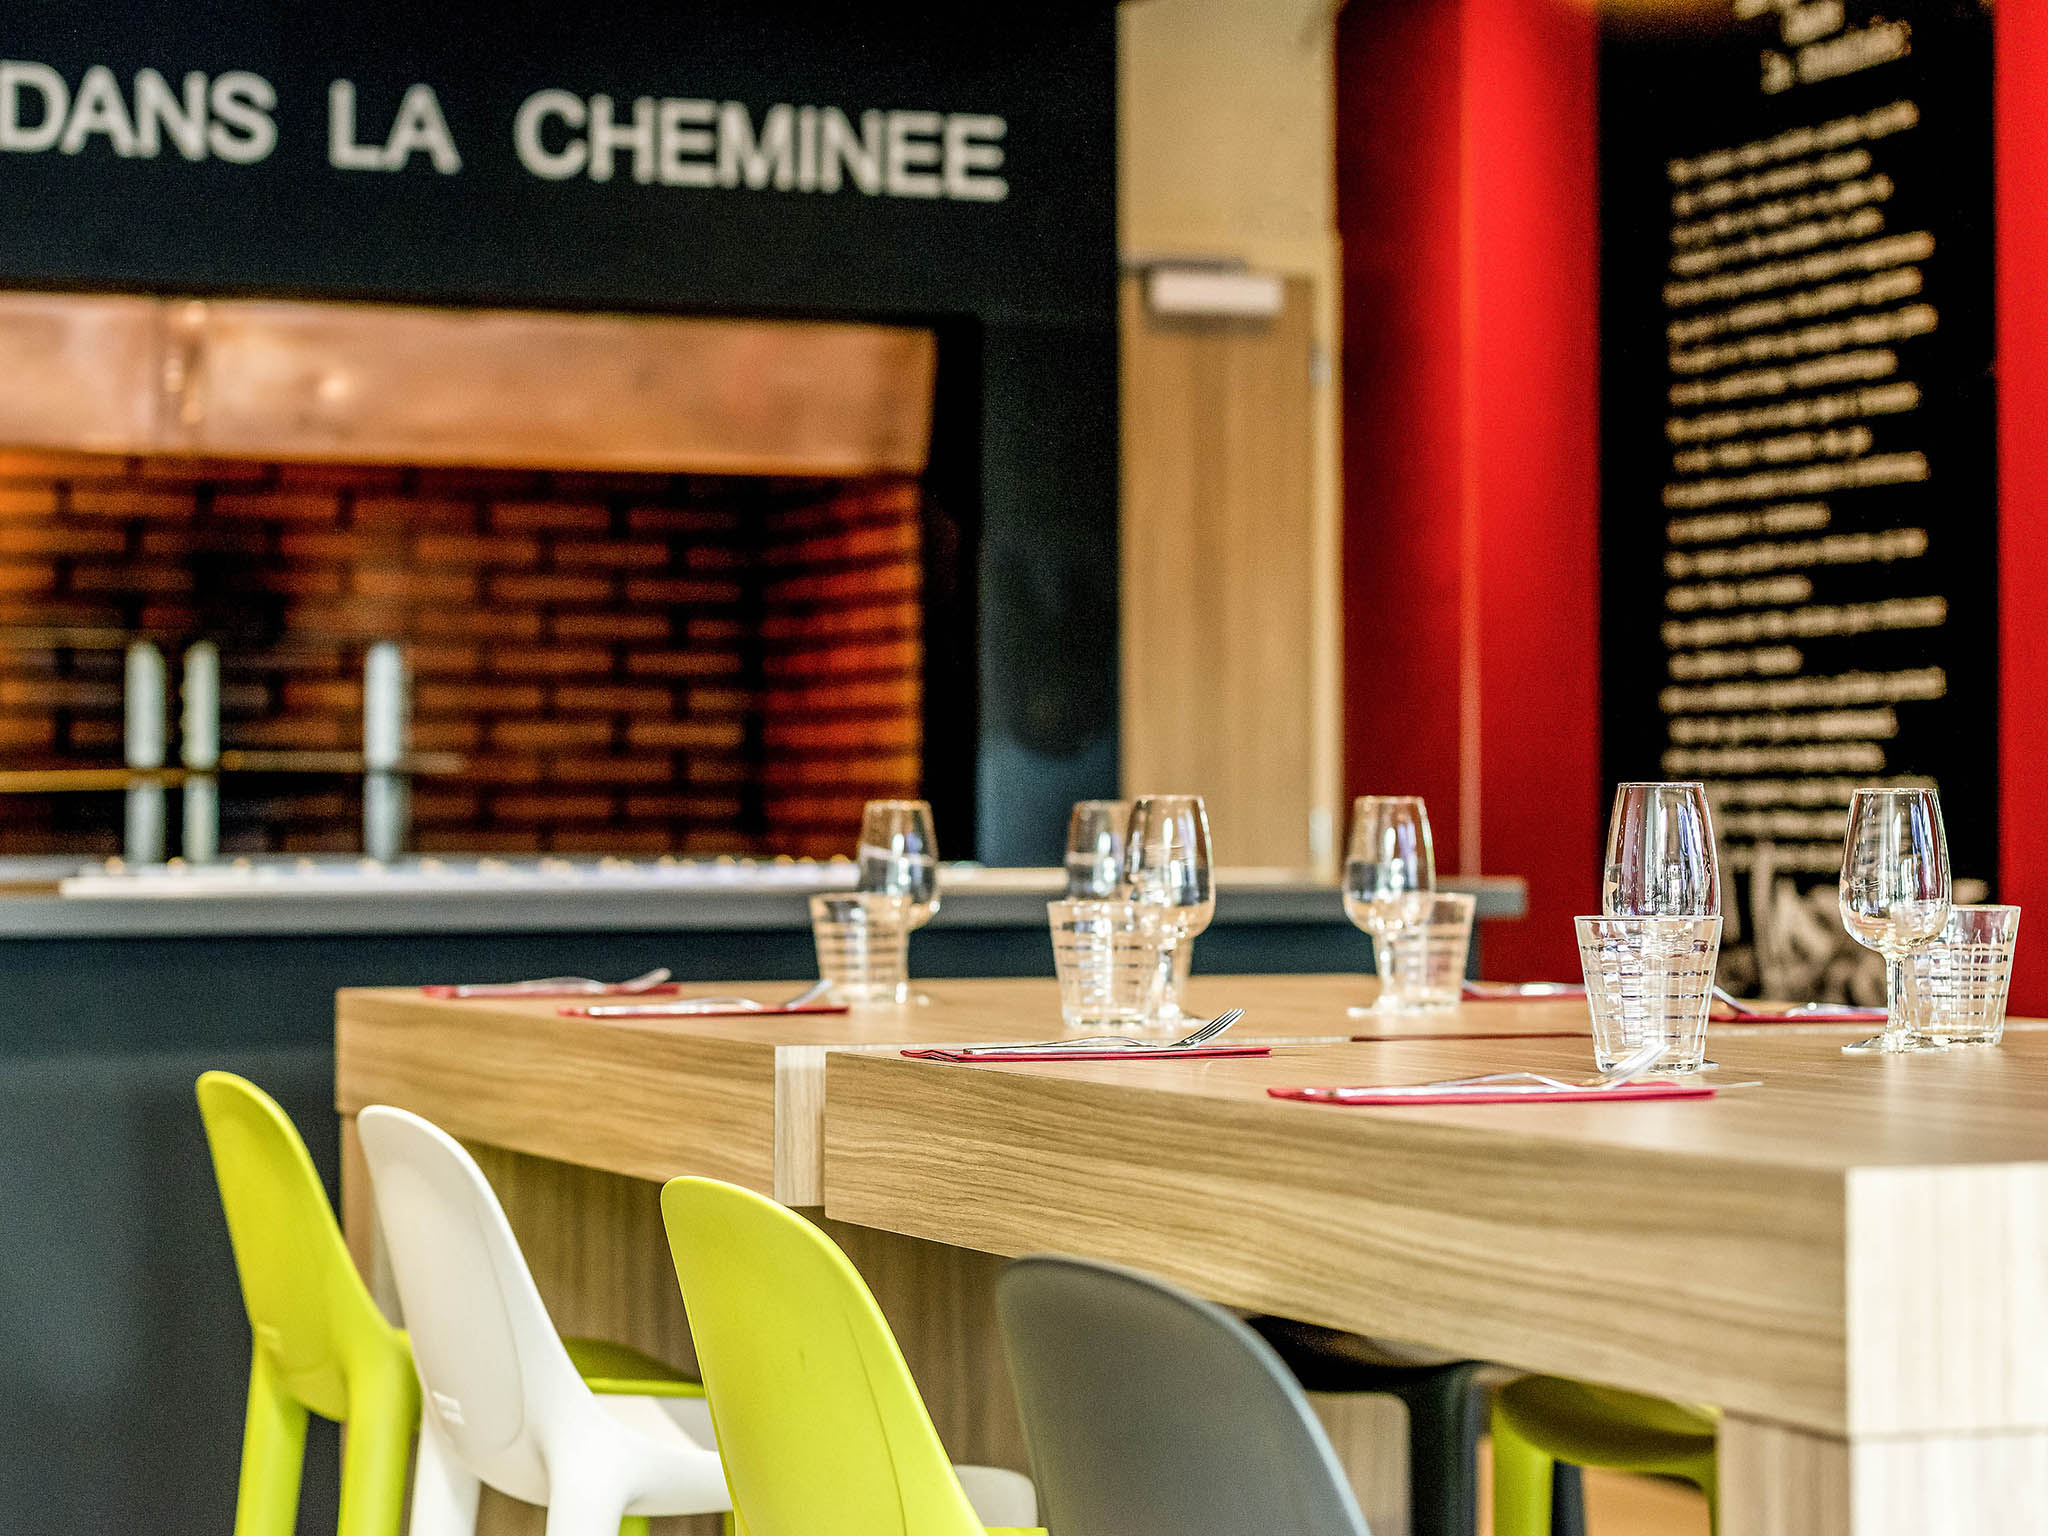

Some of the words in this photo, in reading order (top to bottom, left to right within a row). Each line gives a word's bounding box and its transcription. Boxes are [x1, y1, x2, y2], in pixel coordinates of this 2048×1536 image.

[0, 61, 277, 163] DANS
[329, 79, 461, 173] LA
[515, 90, 1008, 201] CHEMINEE
